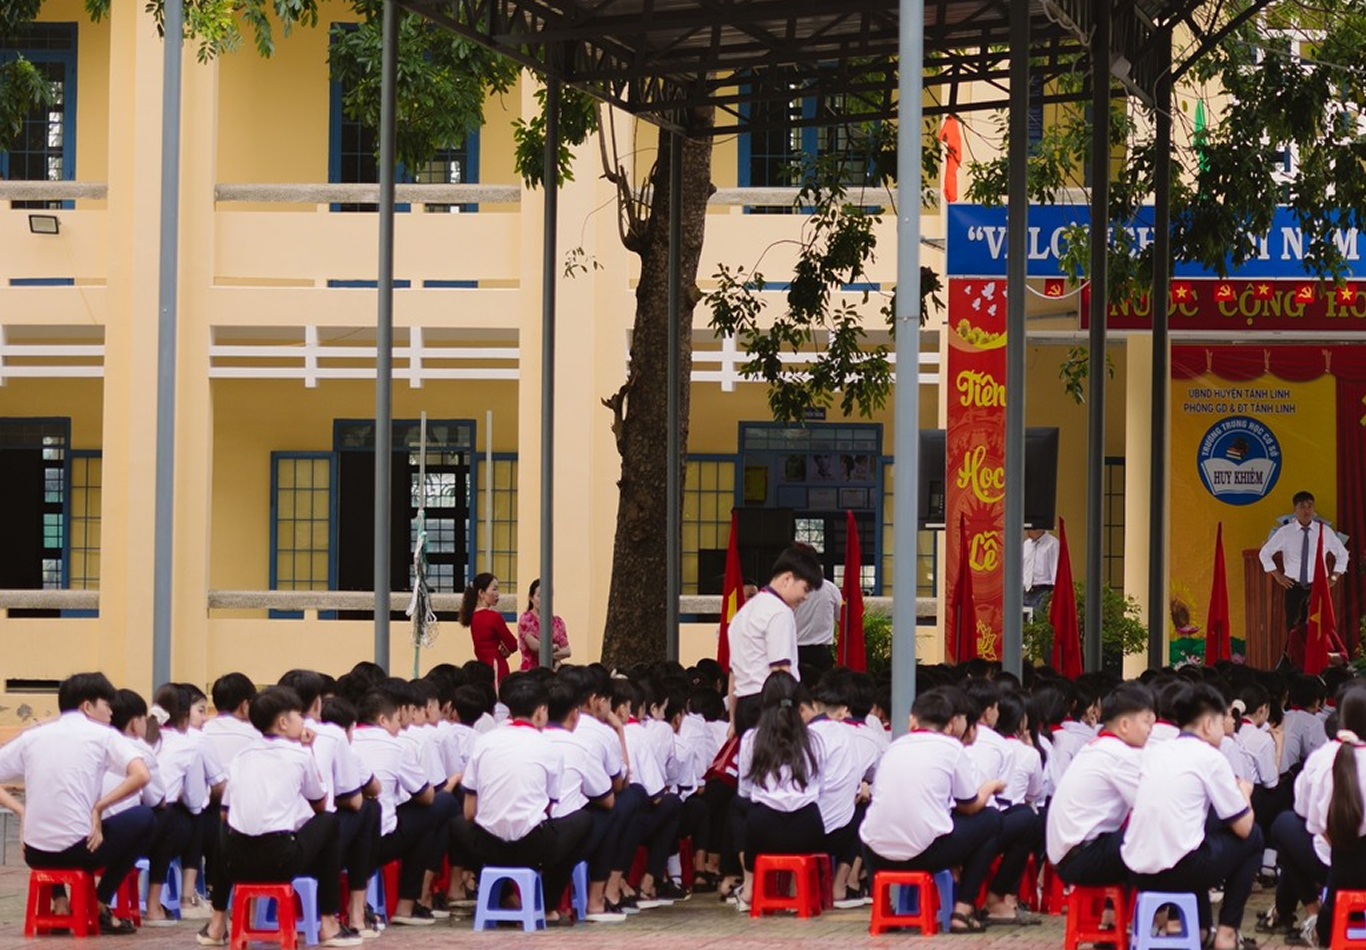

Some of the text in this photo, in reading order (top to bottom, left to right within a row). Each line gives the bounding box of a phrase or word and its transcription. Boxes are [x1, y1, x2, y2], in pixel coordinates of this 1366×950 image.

[956, 369, 1007, 407] Tiên
[1189, 389, 1211, 398] UBND
[1270, 389, 1290, 399] LINH
[1275, 404, 1295, 413] LINH
[957, 445, 1005, 502] Học
[1214, 471, 1232, 485] HUY
[968, 530, 998, 573] Lễ
